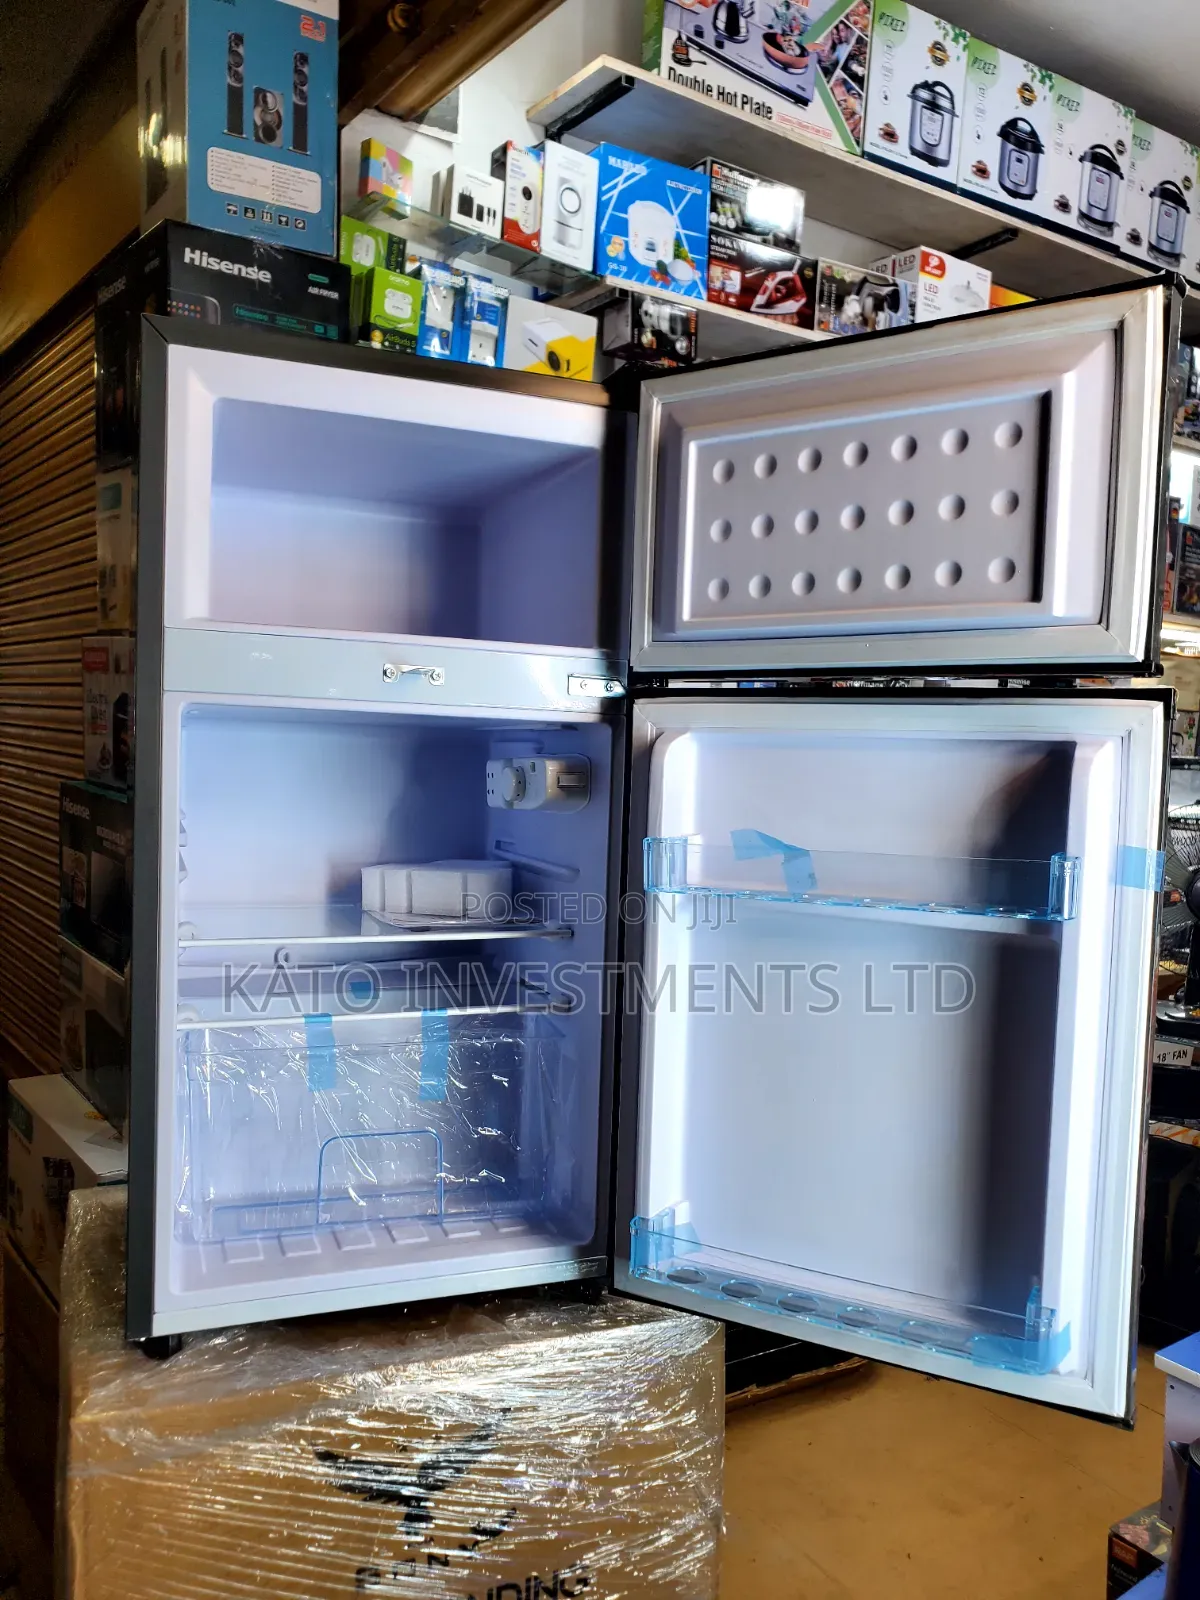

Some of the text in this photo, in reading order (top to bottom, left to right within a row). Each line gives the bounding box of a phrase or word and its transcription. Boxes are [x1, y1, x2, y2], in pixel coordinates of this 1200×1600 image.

[667, 66, 773, 121] Double Hot Plate
[183, 247, 272, 283] Hisense
[897, 254, 916, 267] LED
[923, 281, 939, 295] LED
[62, 796, 91, 820] Hisense
[1172, 1048, 1188, 1061] FAN
